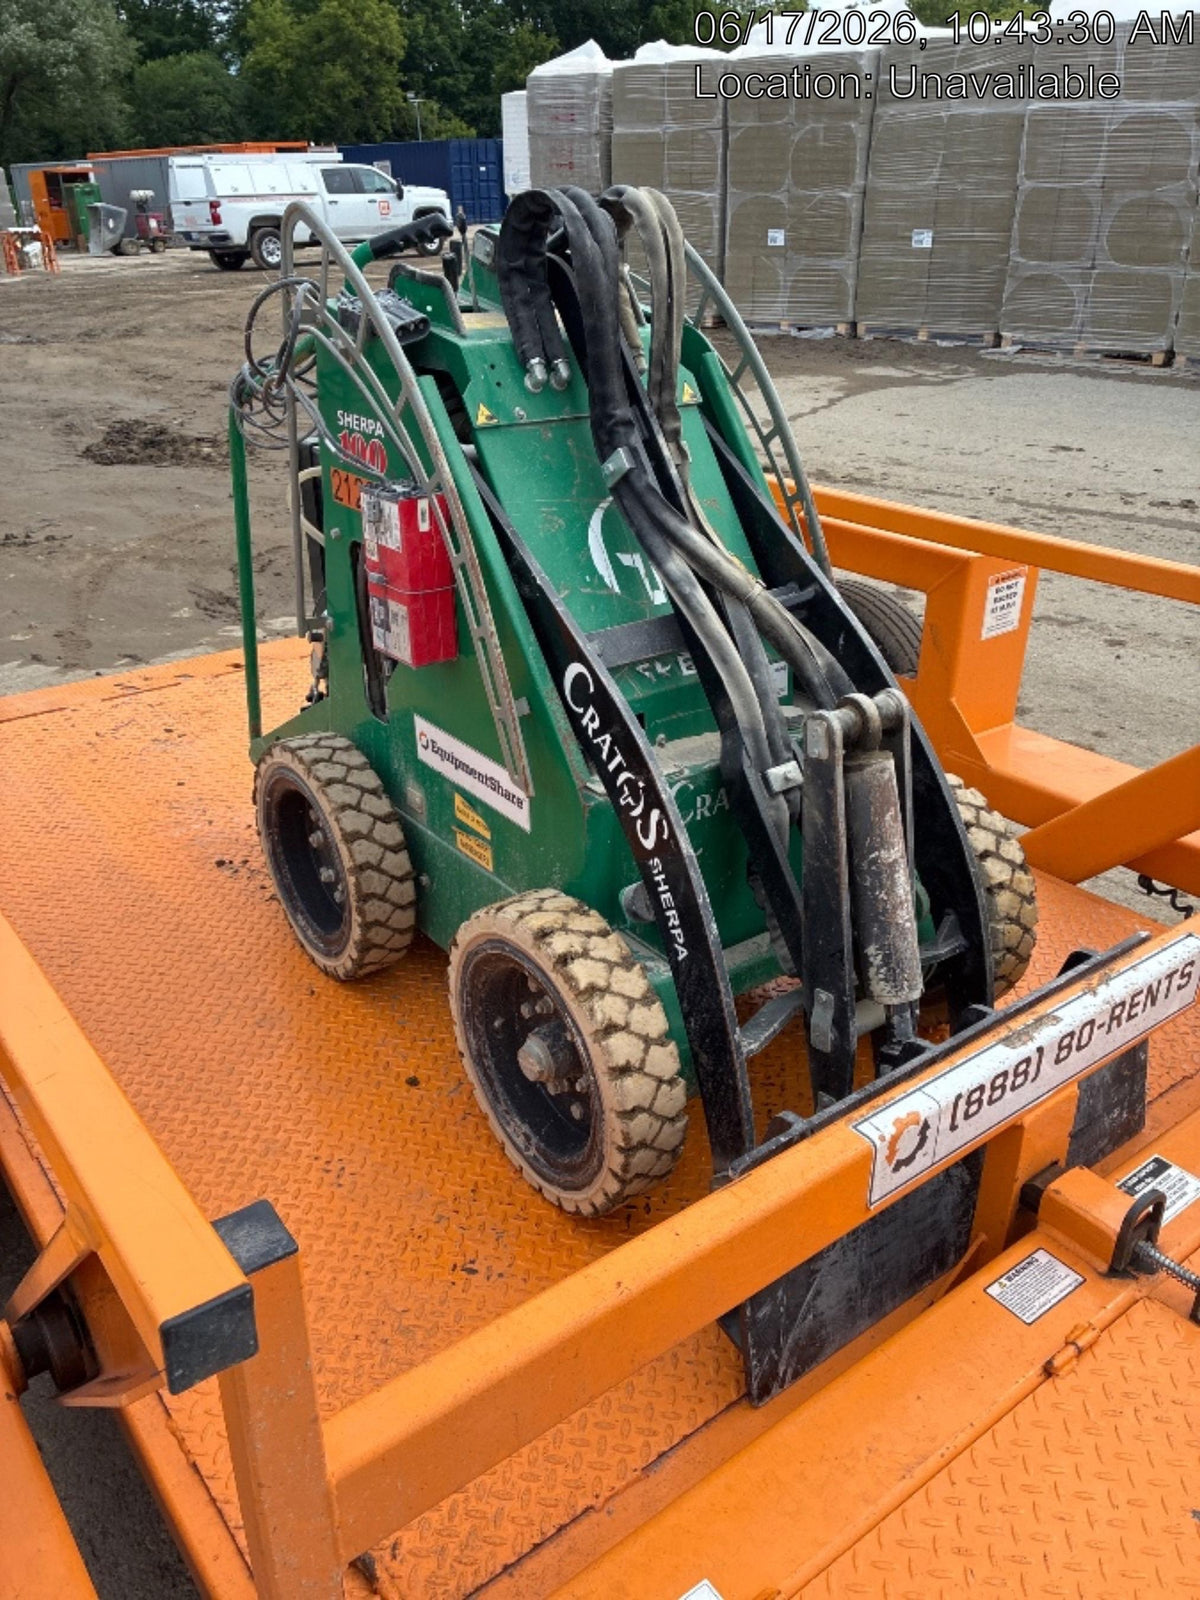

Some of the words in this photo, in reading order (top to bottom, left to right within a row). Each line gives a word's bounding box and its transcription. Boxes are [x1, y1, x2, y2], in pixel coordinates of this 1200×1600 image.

[337, 410, 385, 438] SHERPA
[338, 428, 388, 476] 100
[430, 738, 524, 810] EquipmentShare
[648, 856, 689, 961] SHERPA
[949, 1046, 1045, 1132] (888)
[1053, 960, 1196, 1066] 80-RENTS
[1004, 1256, 1040, 1282] WARNING
